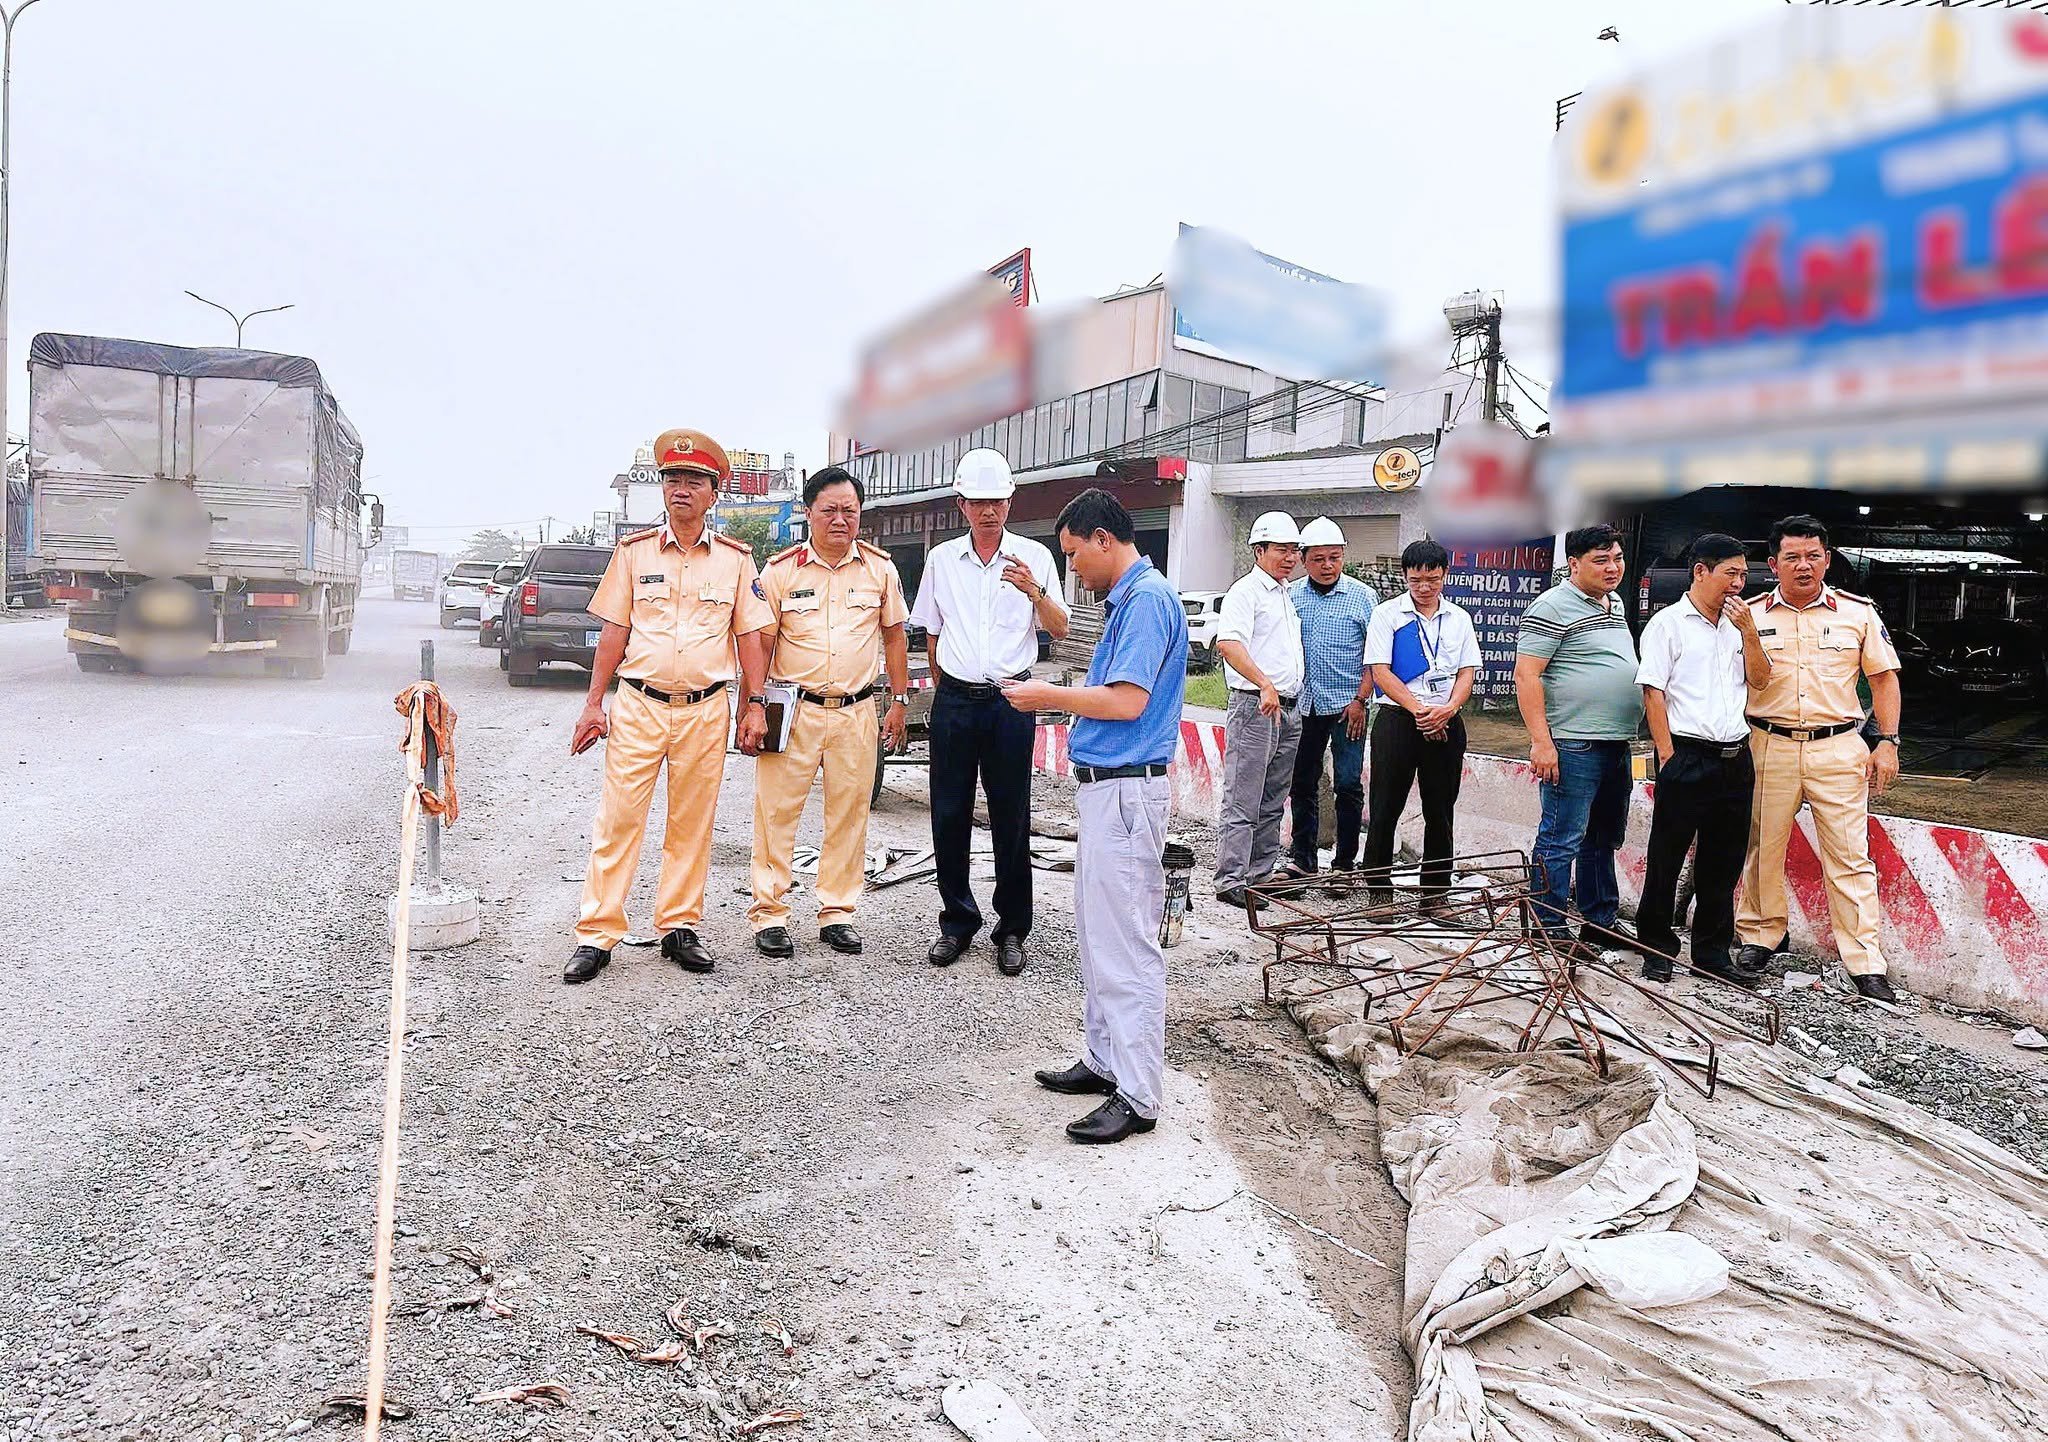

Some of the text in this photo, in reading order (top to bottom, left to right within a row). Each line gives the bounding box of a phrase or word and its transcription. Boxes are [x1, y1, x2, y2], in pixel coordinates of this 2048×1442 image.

[1472, 570, 1511, 592] RỬA
[1517, 577, 1541, 594] XE
[1455, 596, 1481, 606] PHIM
[1484, 595, 1511, 607] CÁCH
